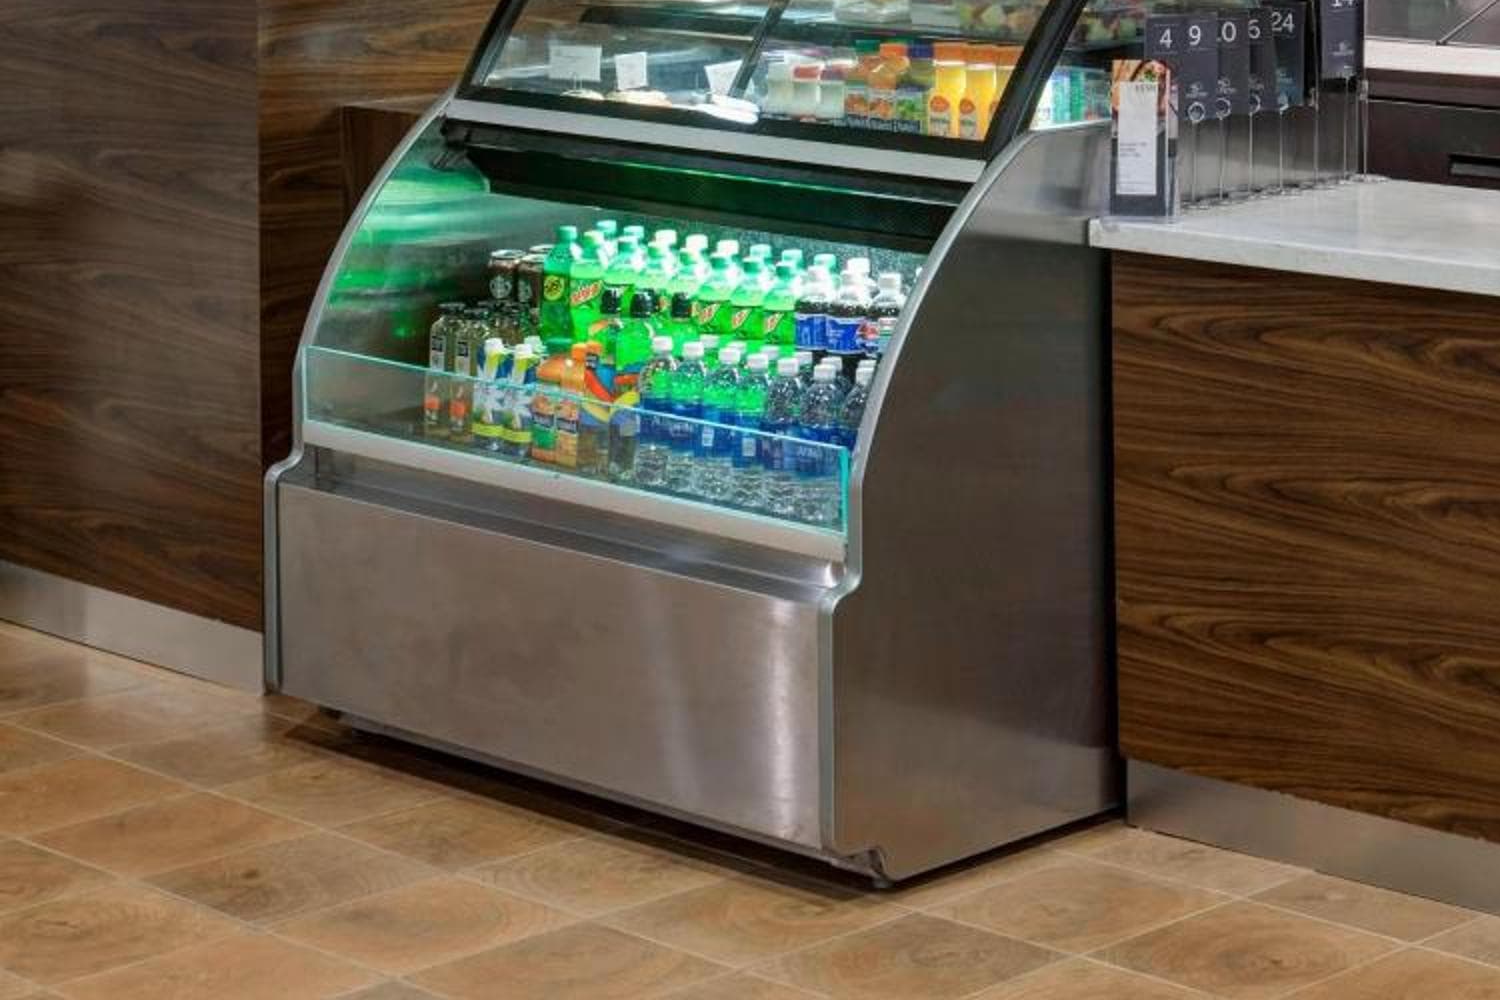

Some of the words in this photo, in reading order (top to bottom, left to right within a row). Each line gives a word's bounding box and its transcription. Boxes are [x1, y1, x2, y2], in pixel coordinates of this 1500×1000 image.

[1271, 11, 1296, 33] 24
[1159, 28, 1173, 49] 4
[1188, 25, 1202, 46] 9
